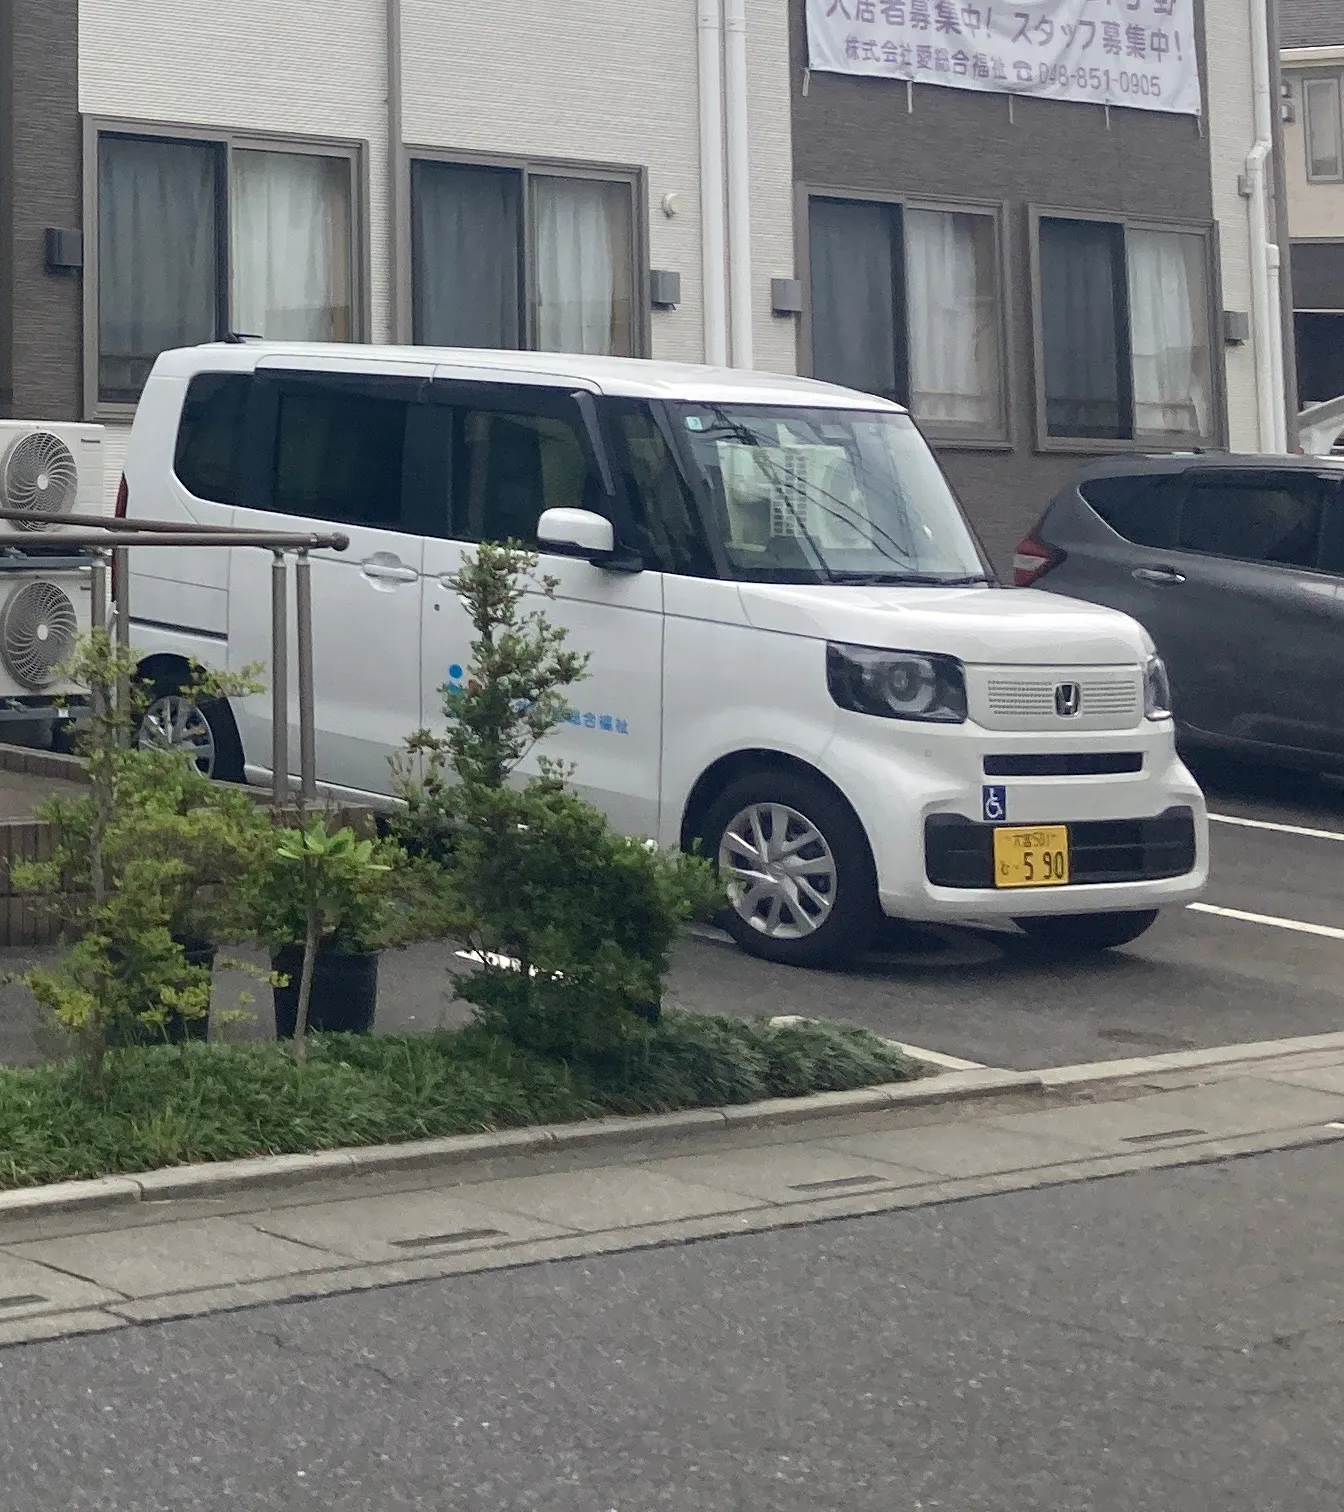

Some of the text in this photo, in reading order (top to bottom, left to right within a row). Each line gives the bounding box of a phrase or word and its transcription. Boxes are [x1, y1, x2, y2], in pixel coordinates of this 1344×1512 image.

[1012, 12, 1183, 63] スタッフ募集中！
